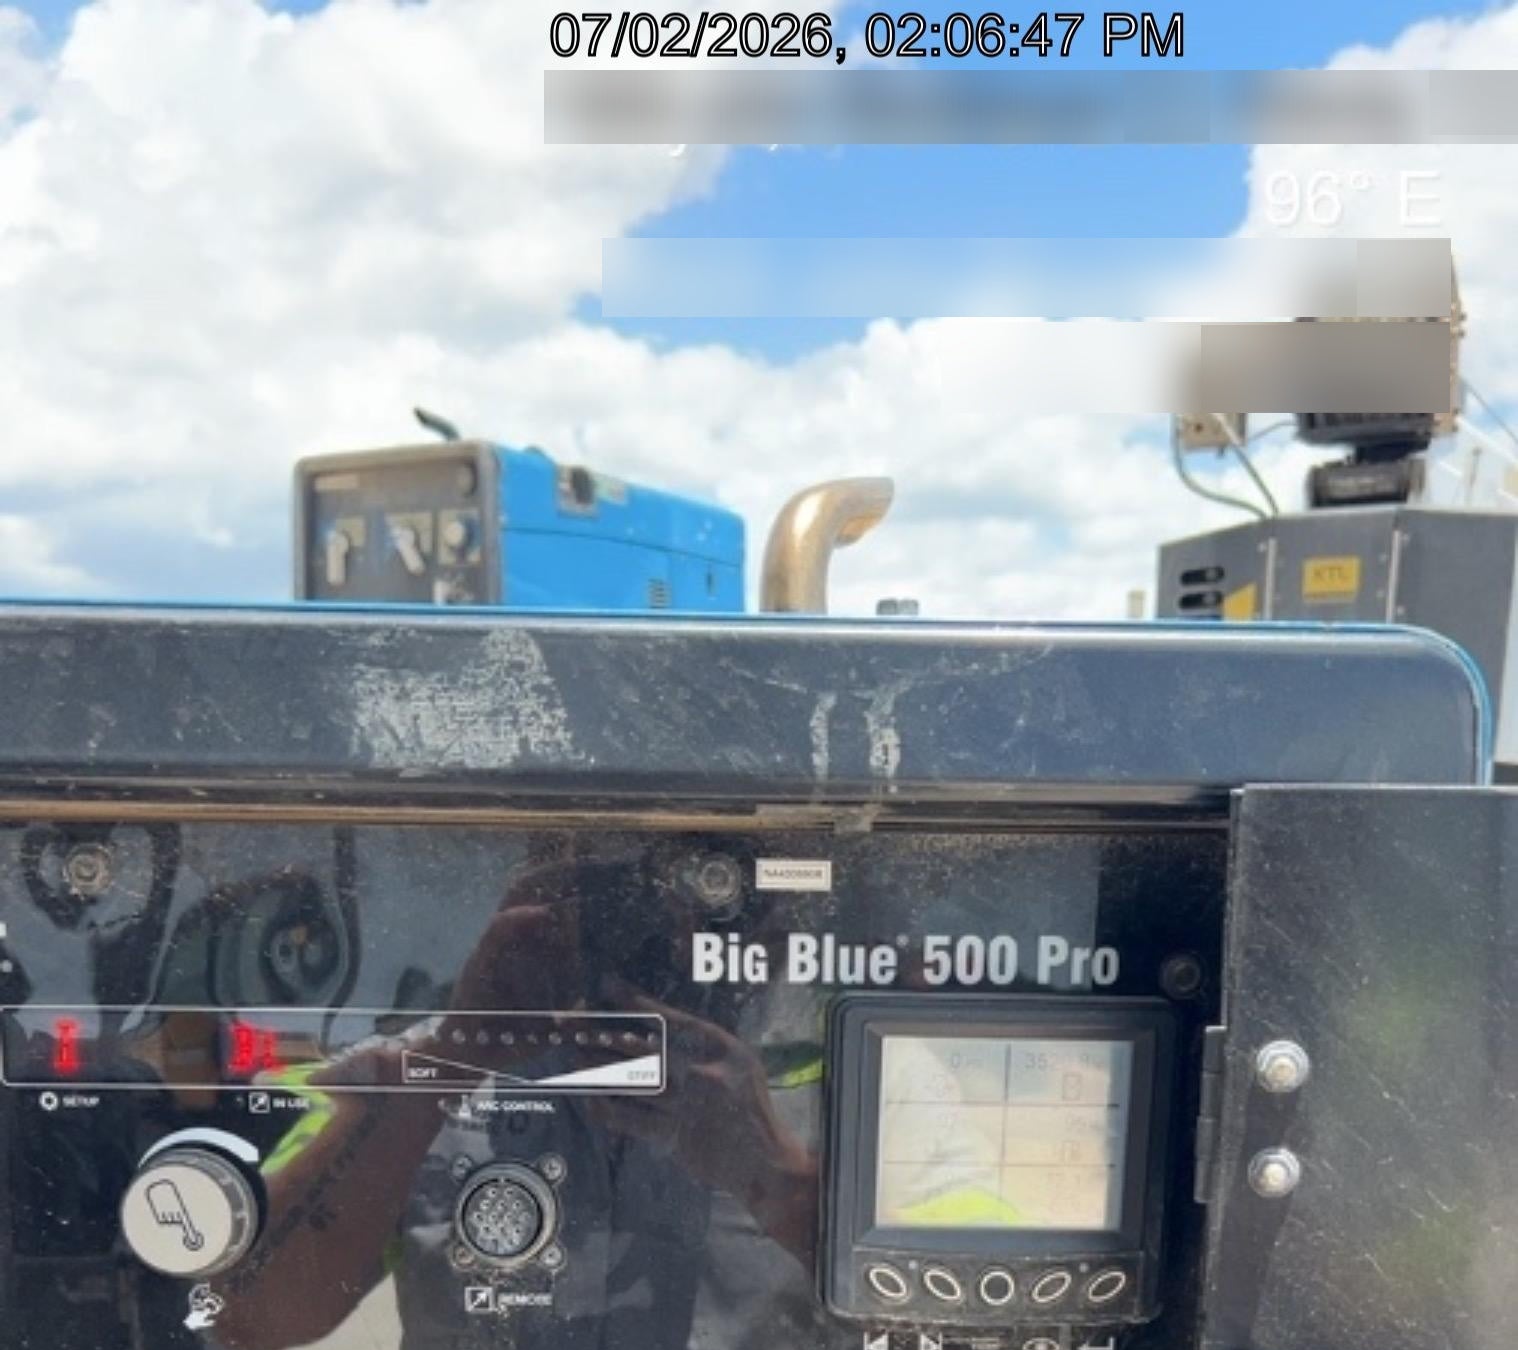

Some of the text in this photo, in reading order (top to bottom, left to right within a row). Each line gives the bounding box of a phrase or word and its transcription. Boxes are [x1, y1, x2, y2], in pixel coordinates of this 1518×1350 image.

[922, 935, 1019, 985] 500
[1037, 935, 1120, 986] Pro
[499, 1292, 552, 1305] REMOTE
